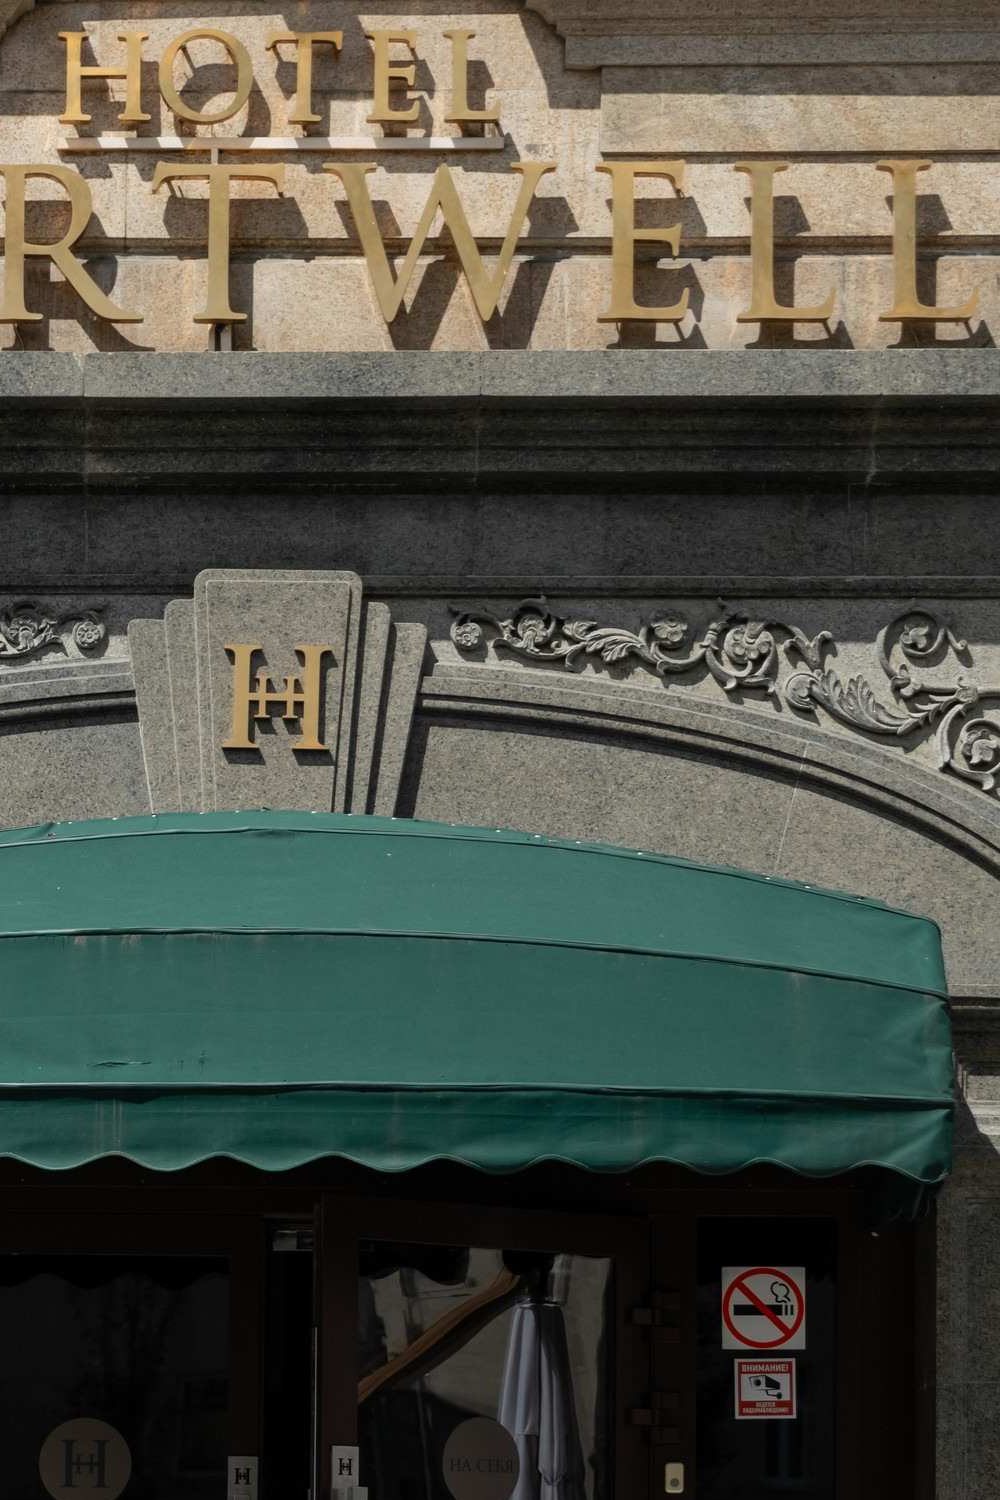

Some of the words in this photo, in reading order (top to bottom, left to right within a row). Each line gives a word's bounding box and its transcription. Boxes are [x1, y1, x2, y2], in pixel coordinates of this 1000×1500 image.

[57, 28, 500, 125] HOTEL
[741, 1363, 789, 1372] ВНИМАНИЕ!
[450, 1457, 472, 1473] НА
[477, 1457, 514, 1474] СЕБЯ
